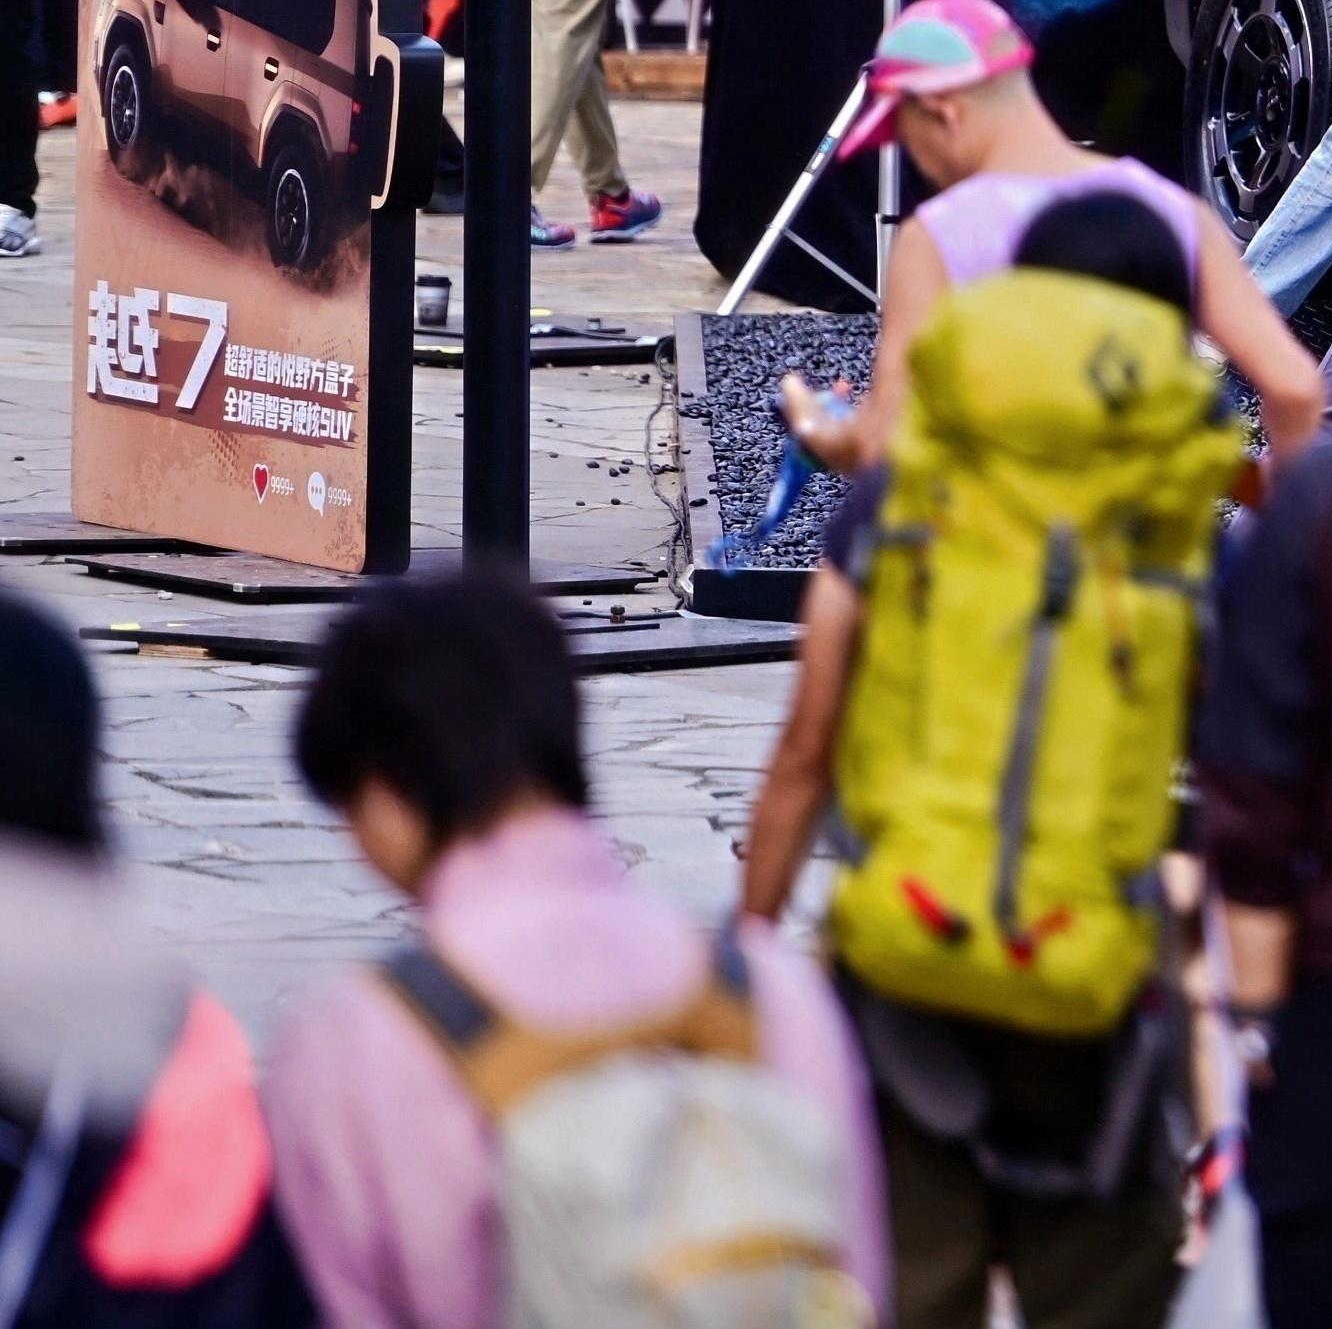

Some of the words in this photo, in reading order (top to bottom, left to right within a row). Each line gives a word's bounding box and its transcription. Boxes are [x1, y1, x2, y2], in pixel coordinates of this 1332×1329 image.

[86, 279, 228, 410] 越7
[224, 342, 354, 398] 超舒适的悦野方盒子
[223, 386, 353, 442] 全场景智享硬核SUV
[270, 475, 295, 496] 9999+
[327, 486, 352, 507] 9999+
